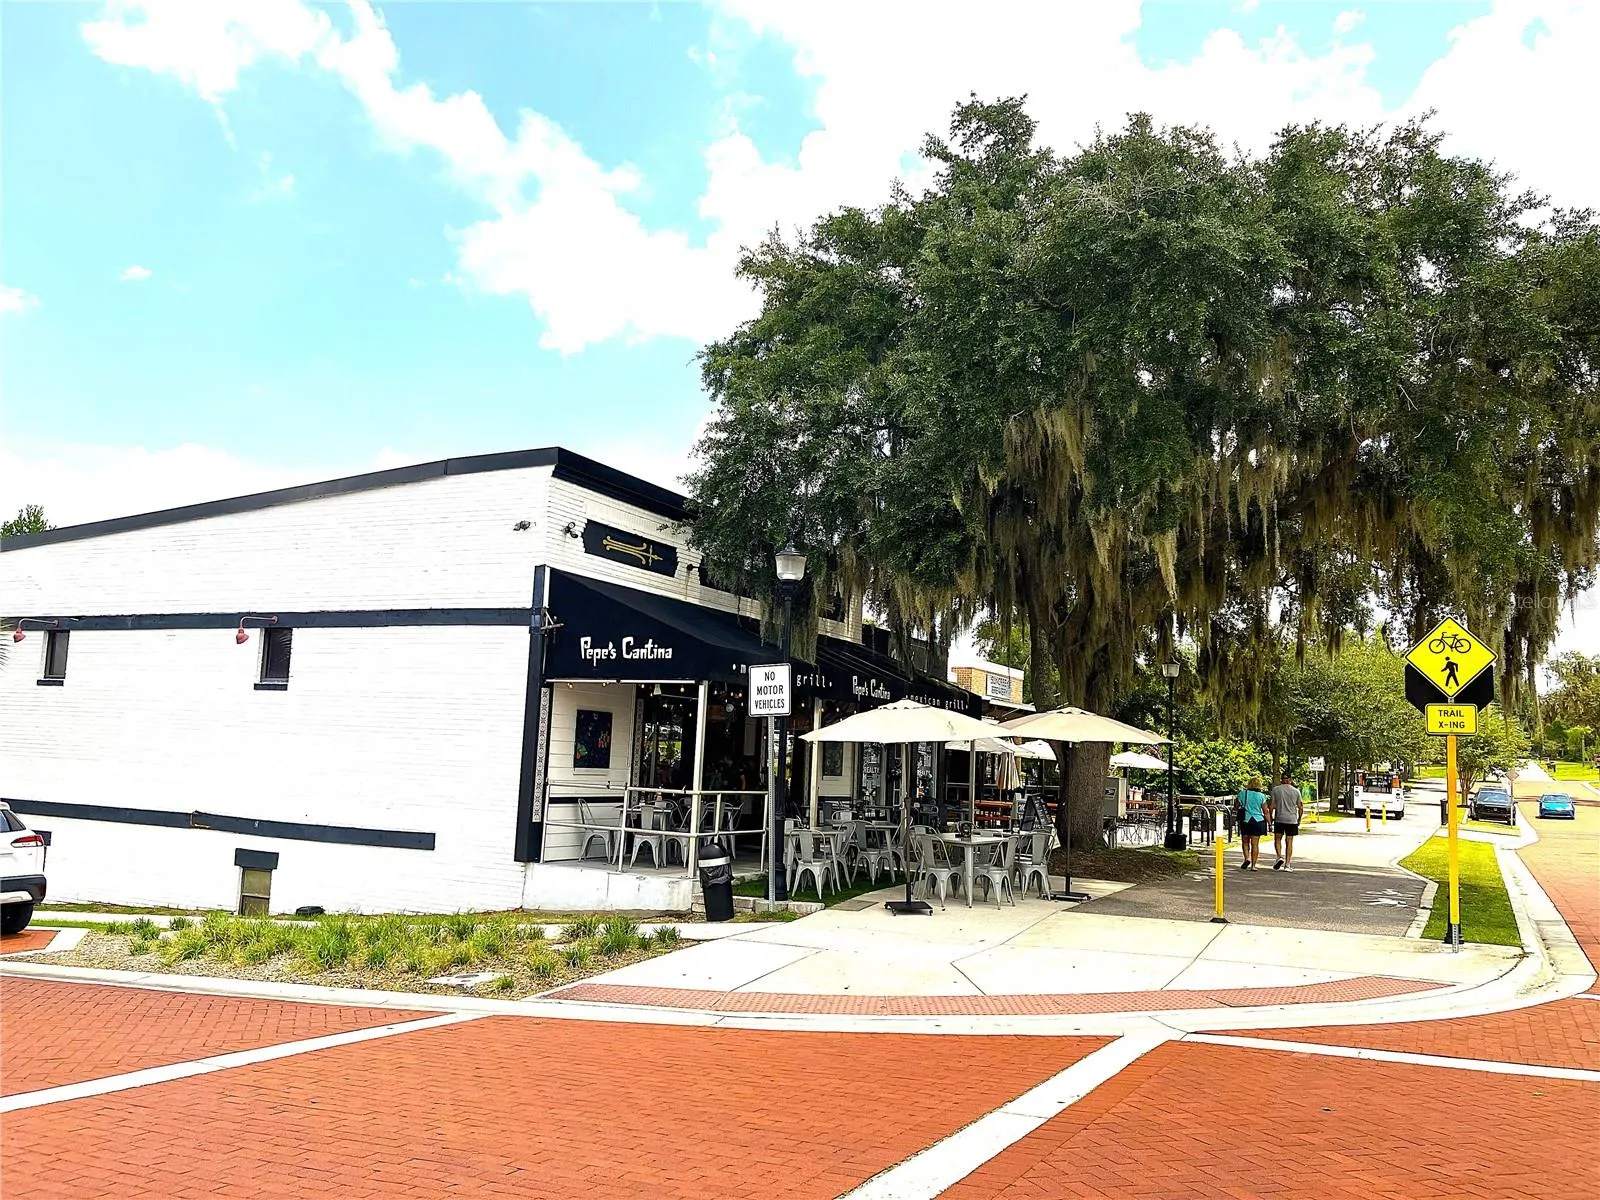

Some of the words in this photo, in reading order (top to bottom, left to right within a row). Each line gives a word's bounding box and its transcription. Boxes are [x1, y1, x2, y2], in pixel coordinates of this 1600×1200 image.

[580, 636, 617, 667] Pepe's
[622, 636, 673, 659] Cantina
[764, 671, 776, 682] NO
[756, 684, 784, 696] MOTOR
[852, 675, 869, 701] Pepe's
[870, 679, 891, 700] Cantina
[754, 698, 785, 710] VEHICLES
[1438, 709, 1465, 718] TRAIL
[1438, 720, 1465, 729] X-ING
